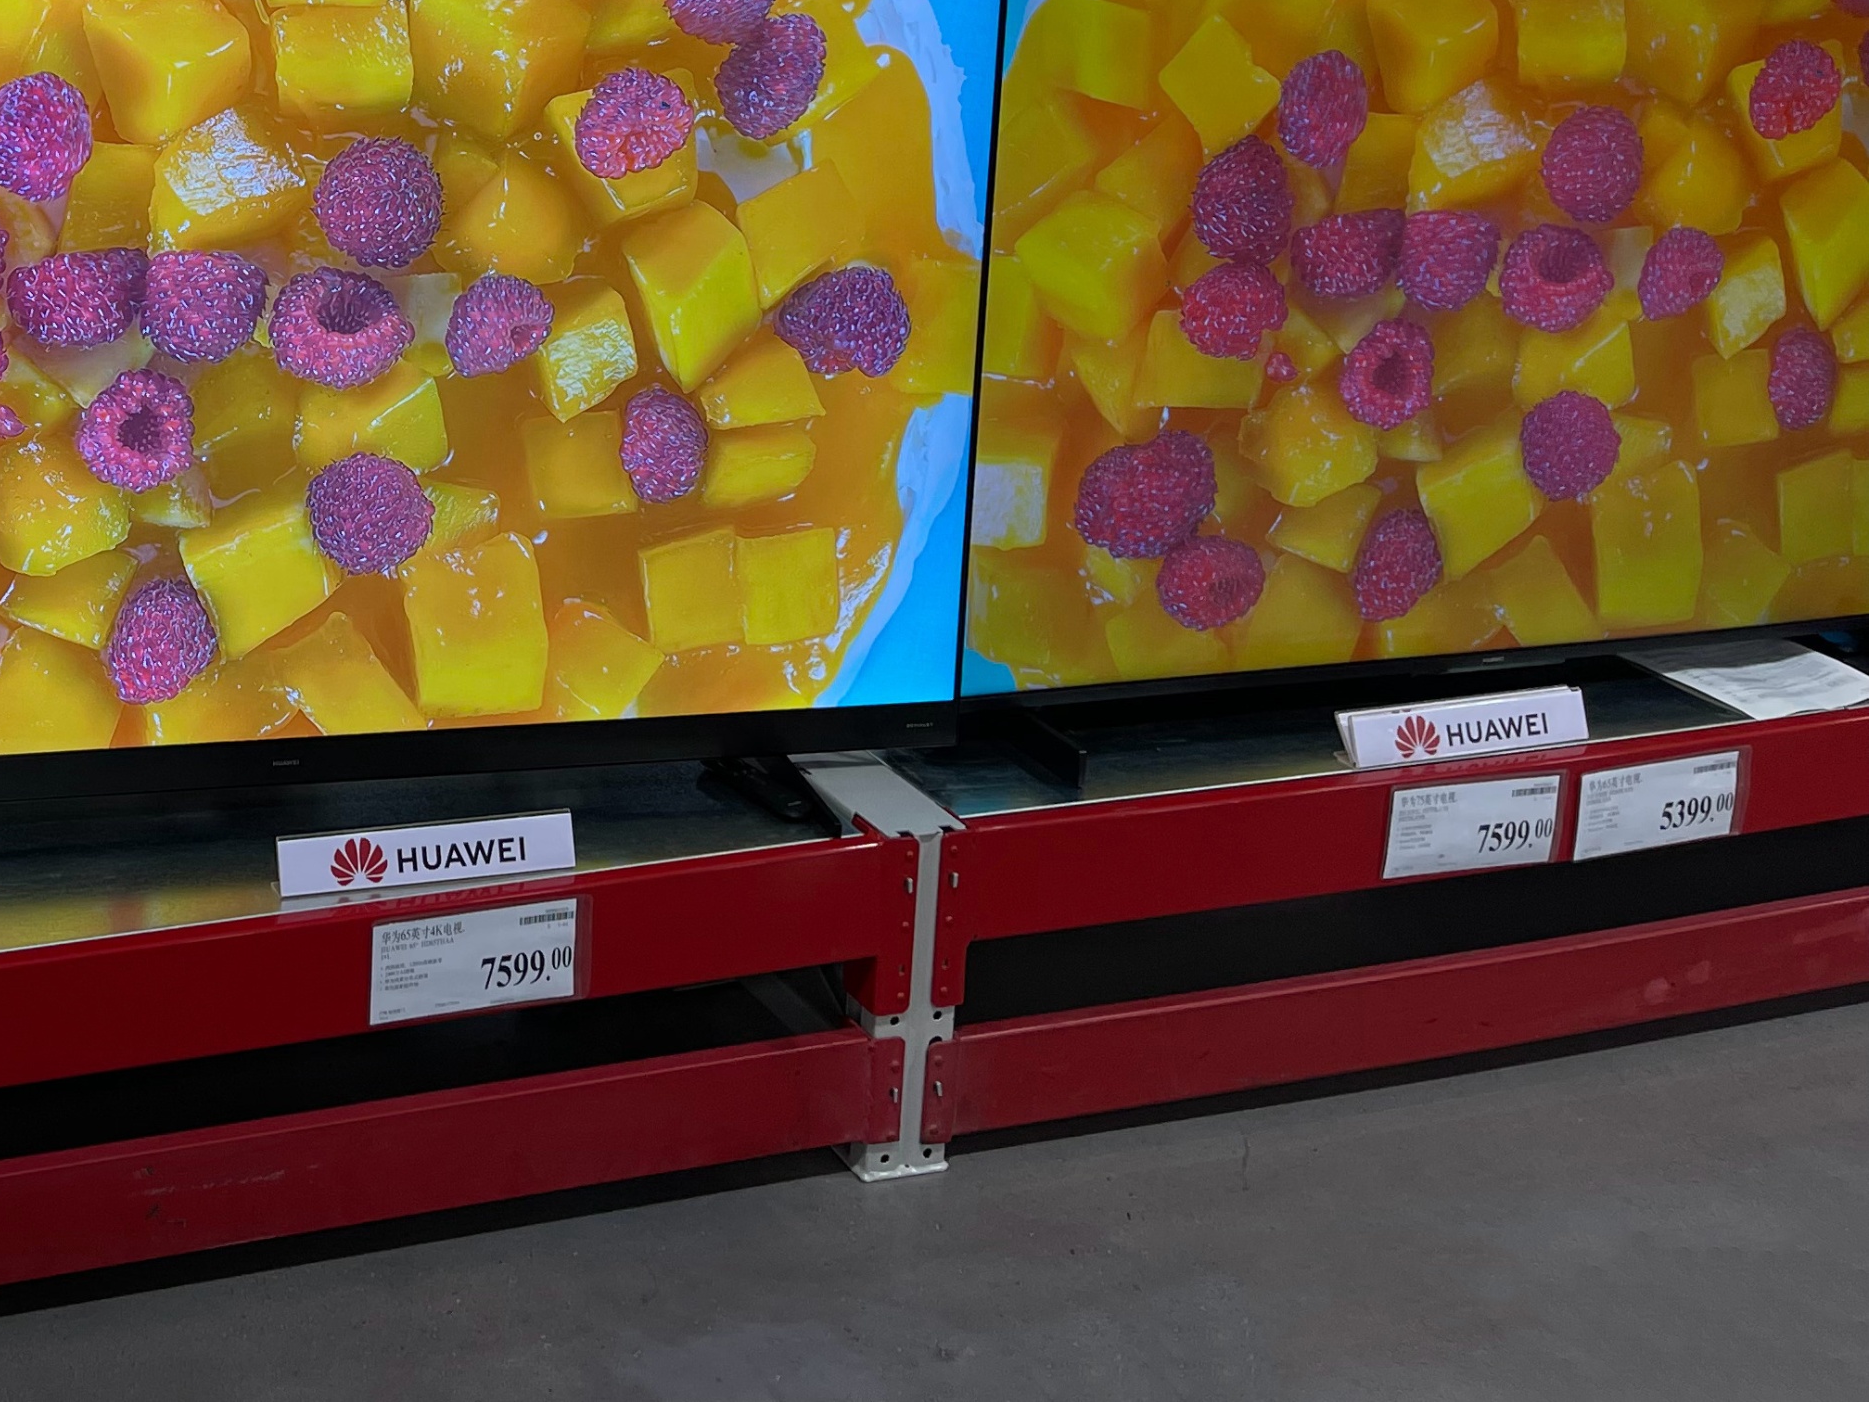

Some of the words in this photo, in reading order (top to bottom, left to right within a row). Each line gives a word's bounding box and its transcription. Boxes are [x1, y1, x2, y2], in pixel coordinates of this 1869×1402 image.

[1445, 711, 1549, 748] HUAWEI
[1659, 792, 1734, 830] 5399.00
[1478, 817, 1553, 854] 7599.00
[396, 836, 526, 874] HUAWEI
[481, 945, 572, 990] 7599.00
